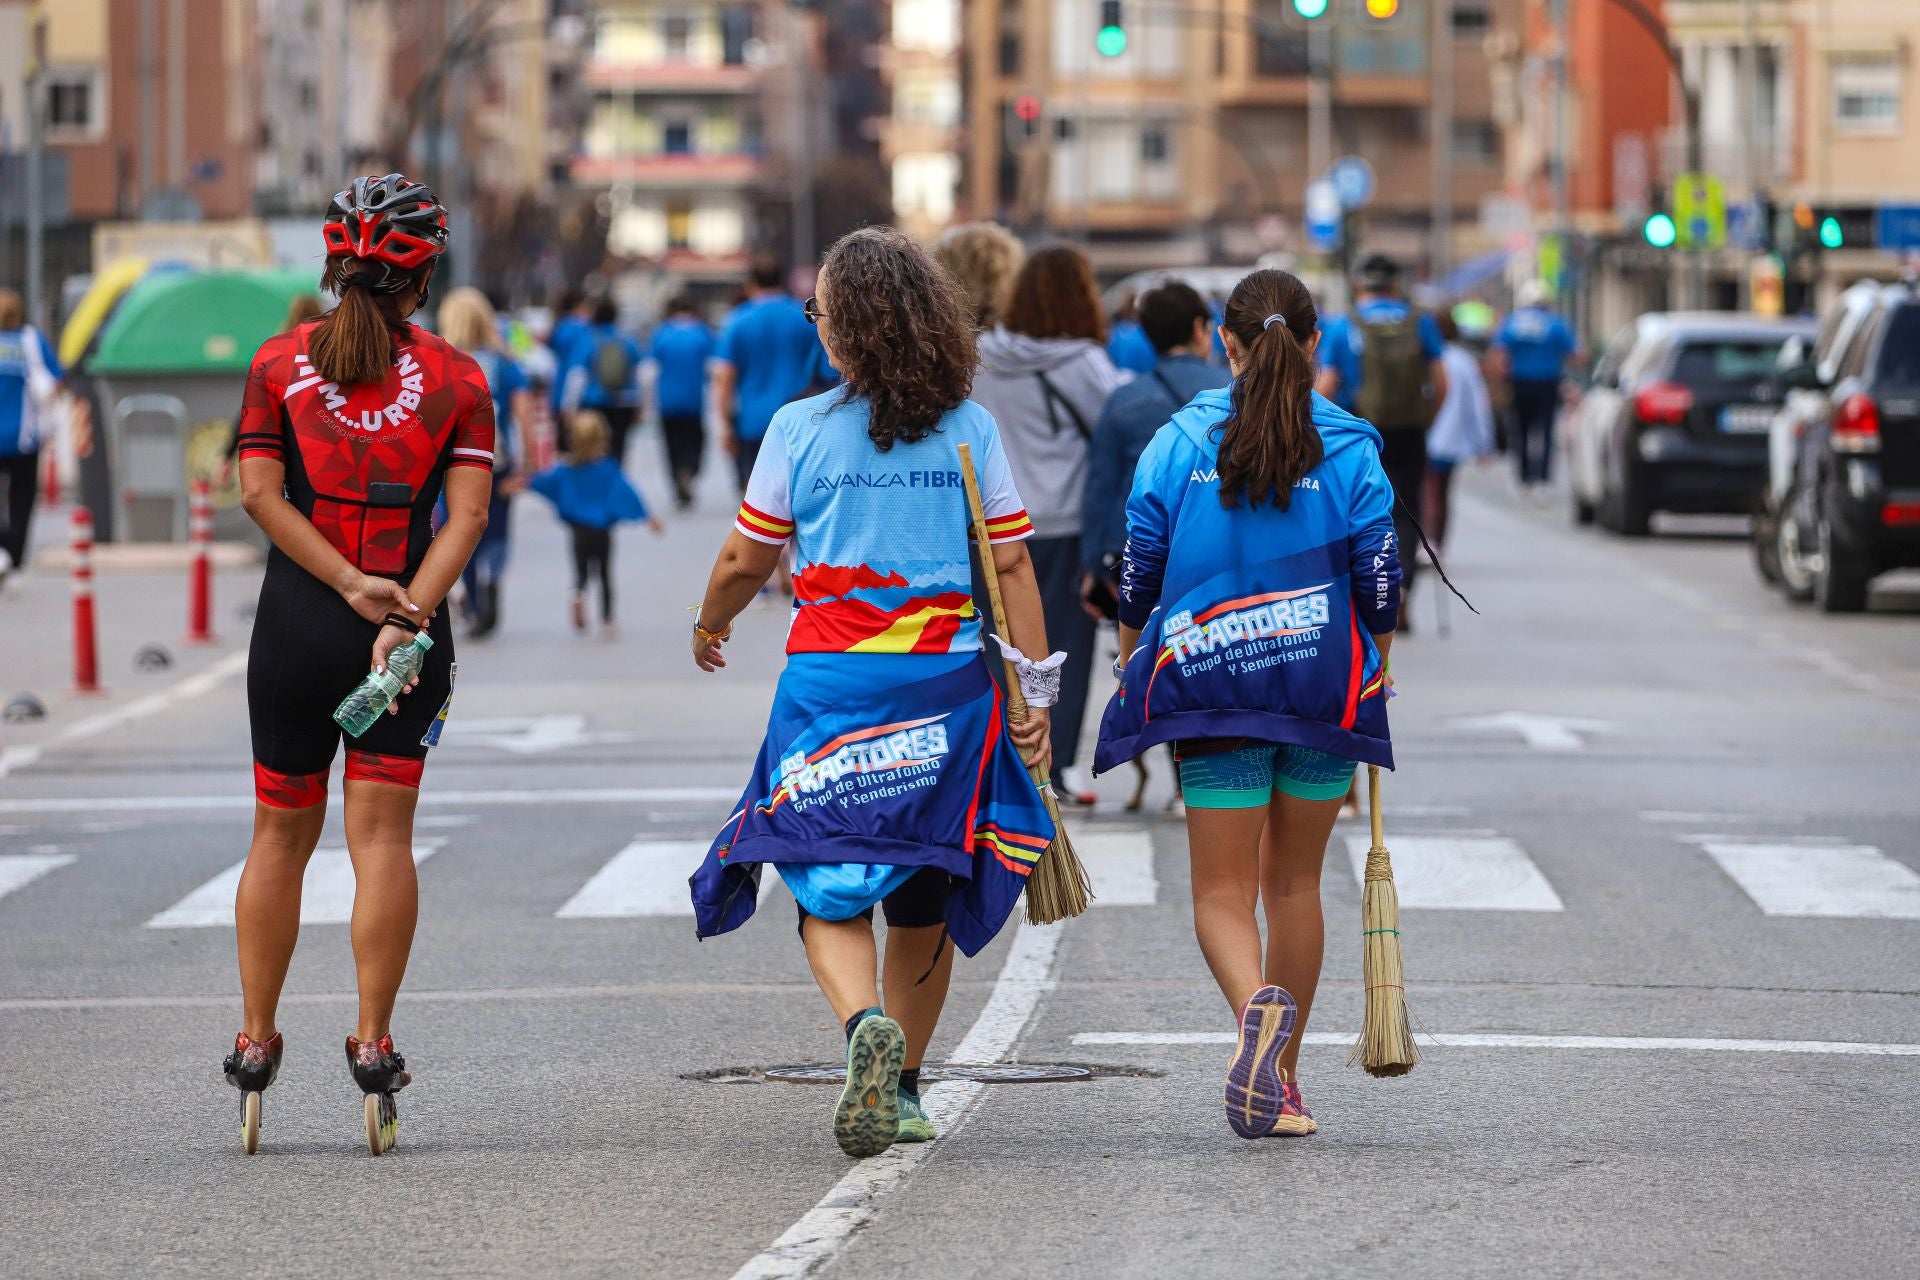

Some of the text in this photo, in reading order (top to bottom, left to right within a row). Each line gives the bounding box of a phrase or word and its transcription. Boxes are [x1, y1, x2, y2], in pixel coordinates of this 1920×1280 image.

[316, 410, 424, 444] patinaje de velocidad
[812, 470, 965, 493] AVANZA FIBR
[1163, 609, 1194, 637] LOS
[1165, 593, 1330, 664] TRACTORES
[1181, 629, 1321, 677] Grupo de Ultrafondo
[1241, 647, 1318, 673] Senderismo
[781, 723, 949, 803] TRACTORES
[781, 750, 806, 779] LOS
[793, 759, 941, 814] Grupo de Ultrafondo
[853, 774, 937, 805] Senderismo
